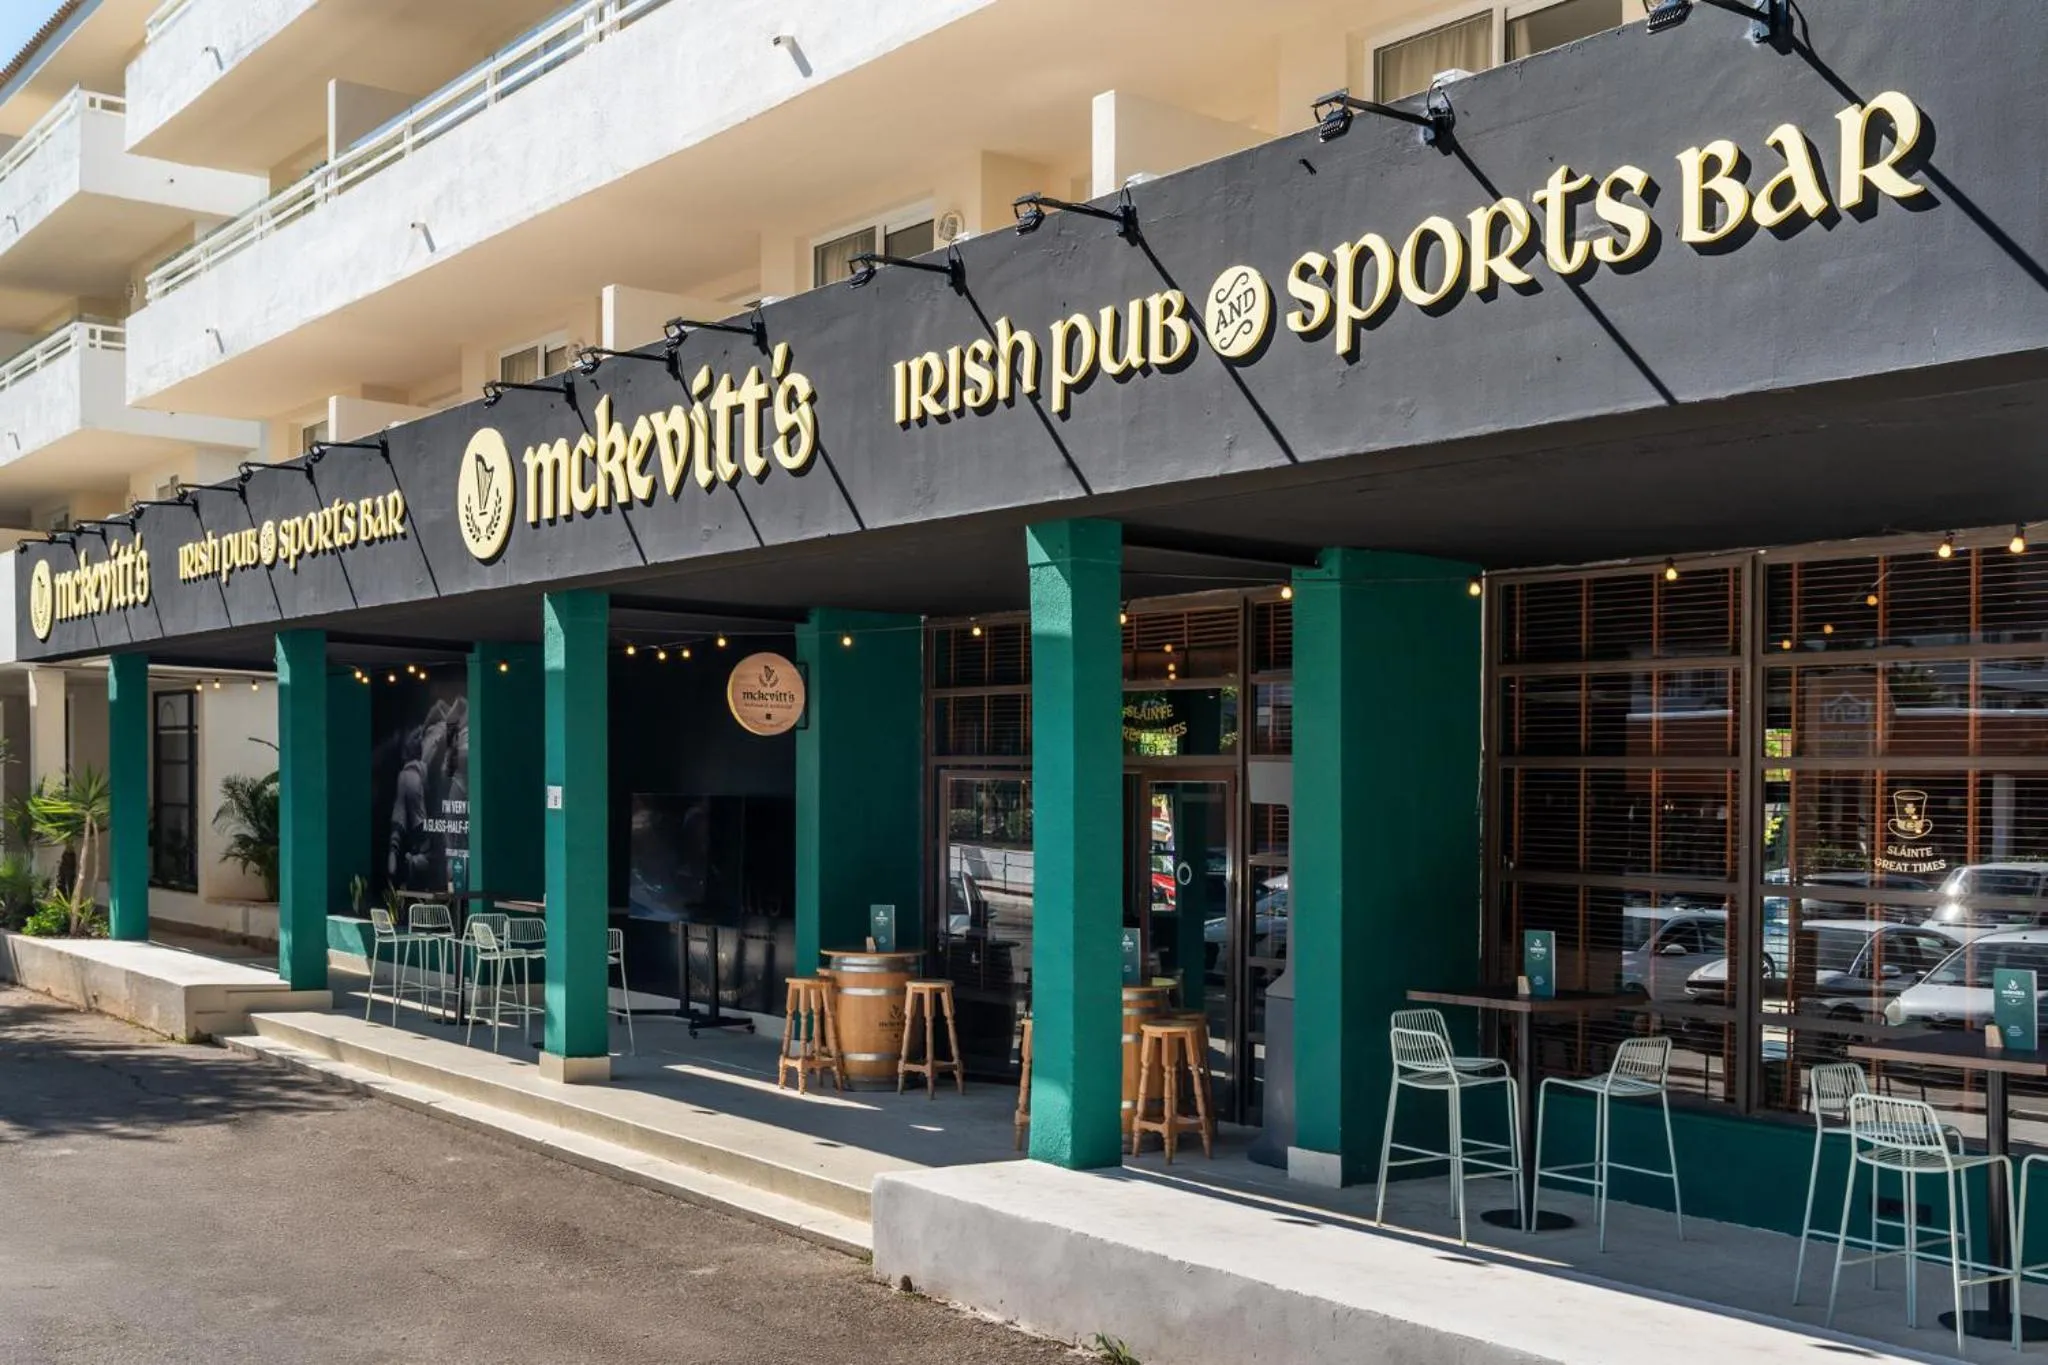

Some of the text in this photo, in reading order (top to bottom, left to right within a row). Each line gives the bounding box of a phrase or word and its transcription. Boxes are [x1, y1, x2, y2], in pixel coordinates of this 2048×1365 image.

[1215, 287, 1256, 335] AND
[1887, 845, 1934, 858] SLÁINTE
[1874, 857, 1947, 873] GREAT TIMES
